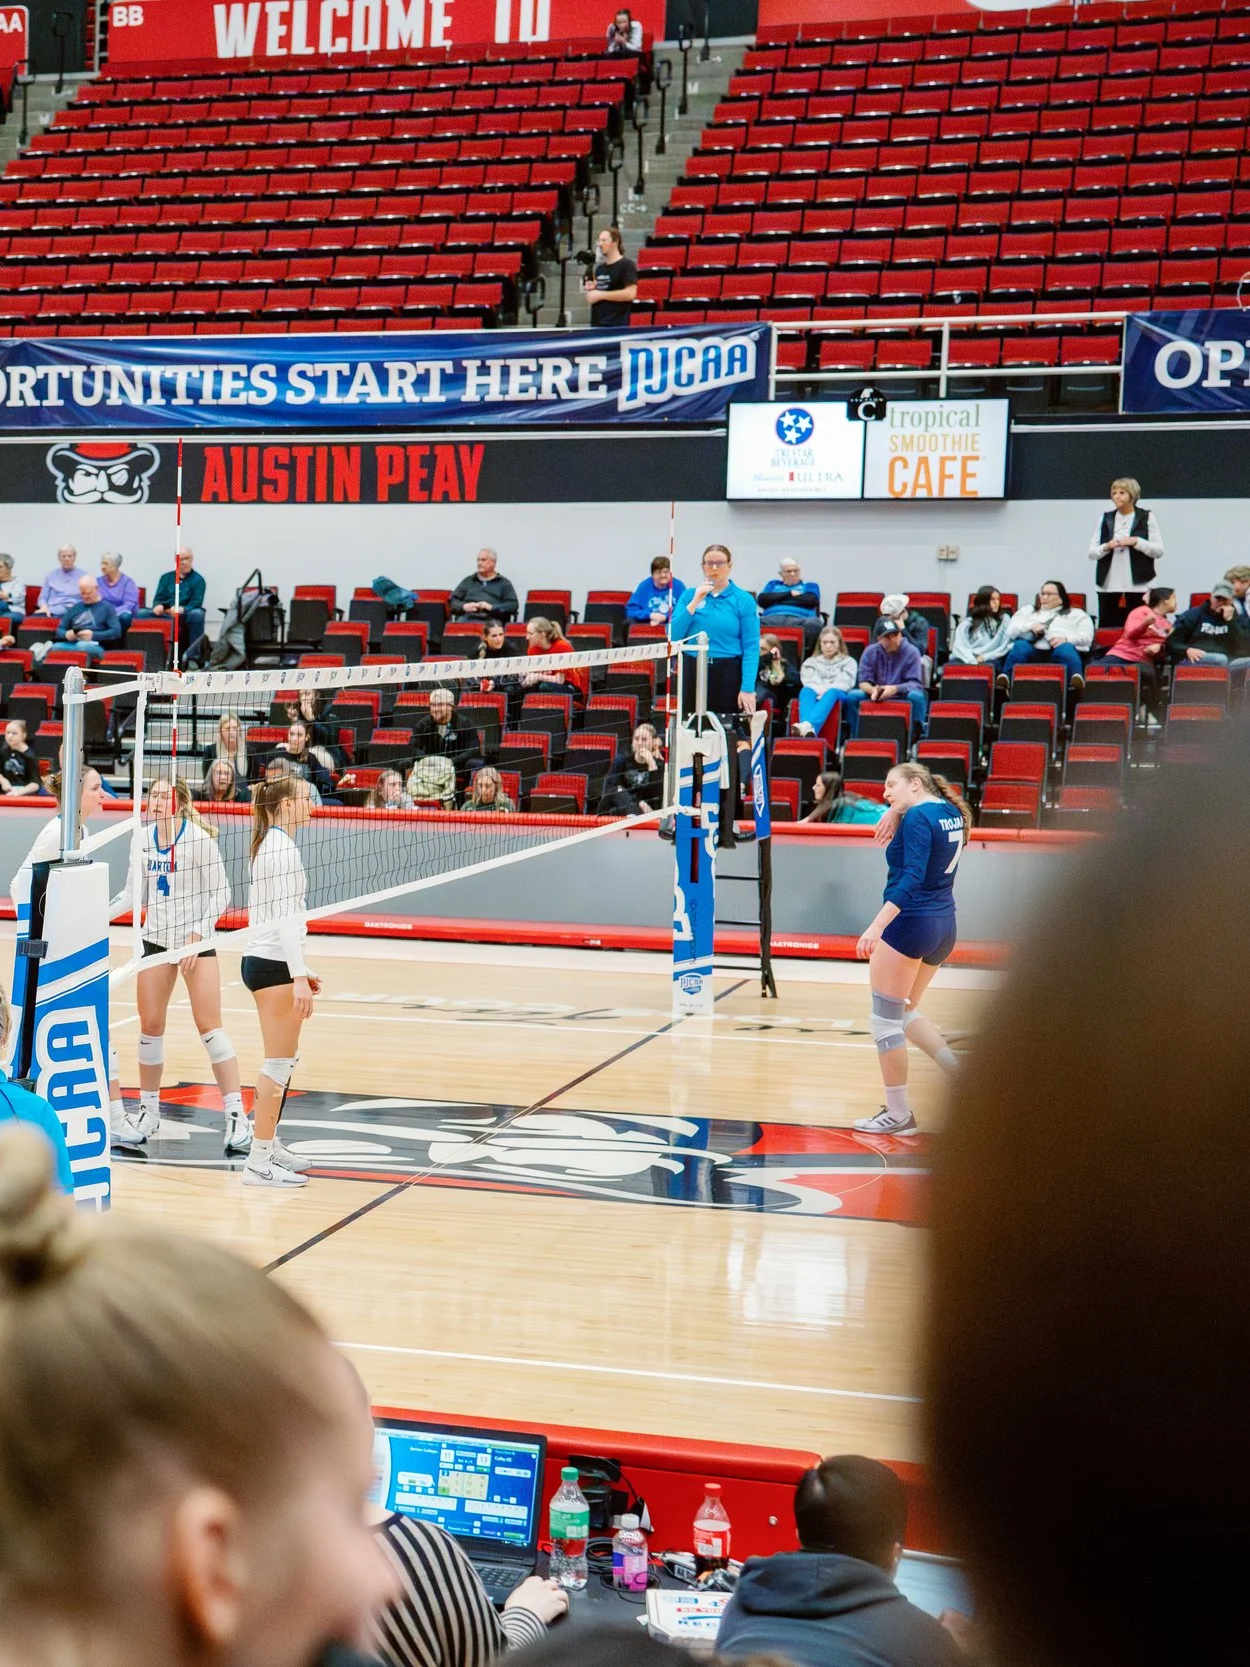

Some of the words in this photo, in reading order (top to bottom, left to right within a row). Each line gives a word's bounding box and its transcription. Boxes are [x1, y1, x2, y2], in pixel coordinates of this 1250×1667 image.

[112, 6, 144, 27] BB
[214, 0, 453, 59] WELCOME
[493, 0, 551, 43] TO
[285, 361, 453, 406] START
[461, 356, 607, 402] HERE
[1154, 340, 1250, 389] OP
[857, 401, 876, 421] C
[890, 403, 981, 432] tropical
[889, 433, 980, 452] SMOOTHIE
[201, 445, 361, 502] AUSTIN
[375, 444, 485, 502] PEAY
[797, 472, 844, 483] ULTRA
[888, 456, 980, 498] CAFE
[947, 830, 963, 873] 7
[157, 875, 170, 896] 4
